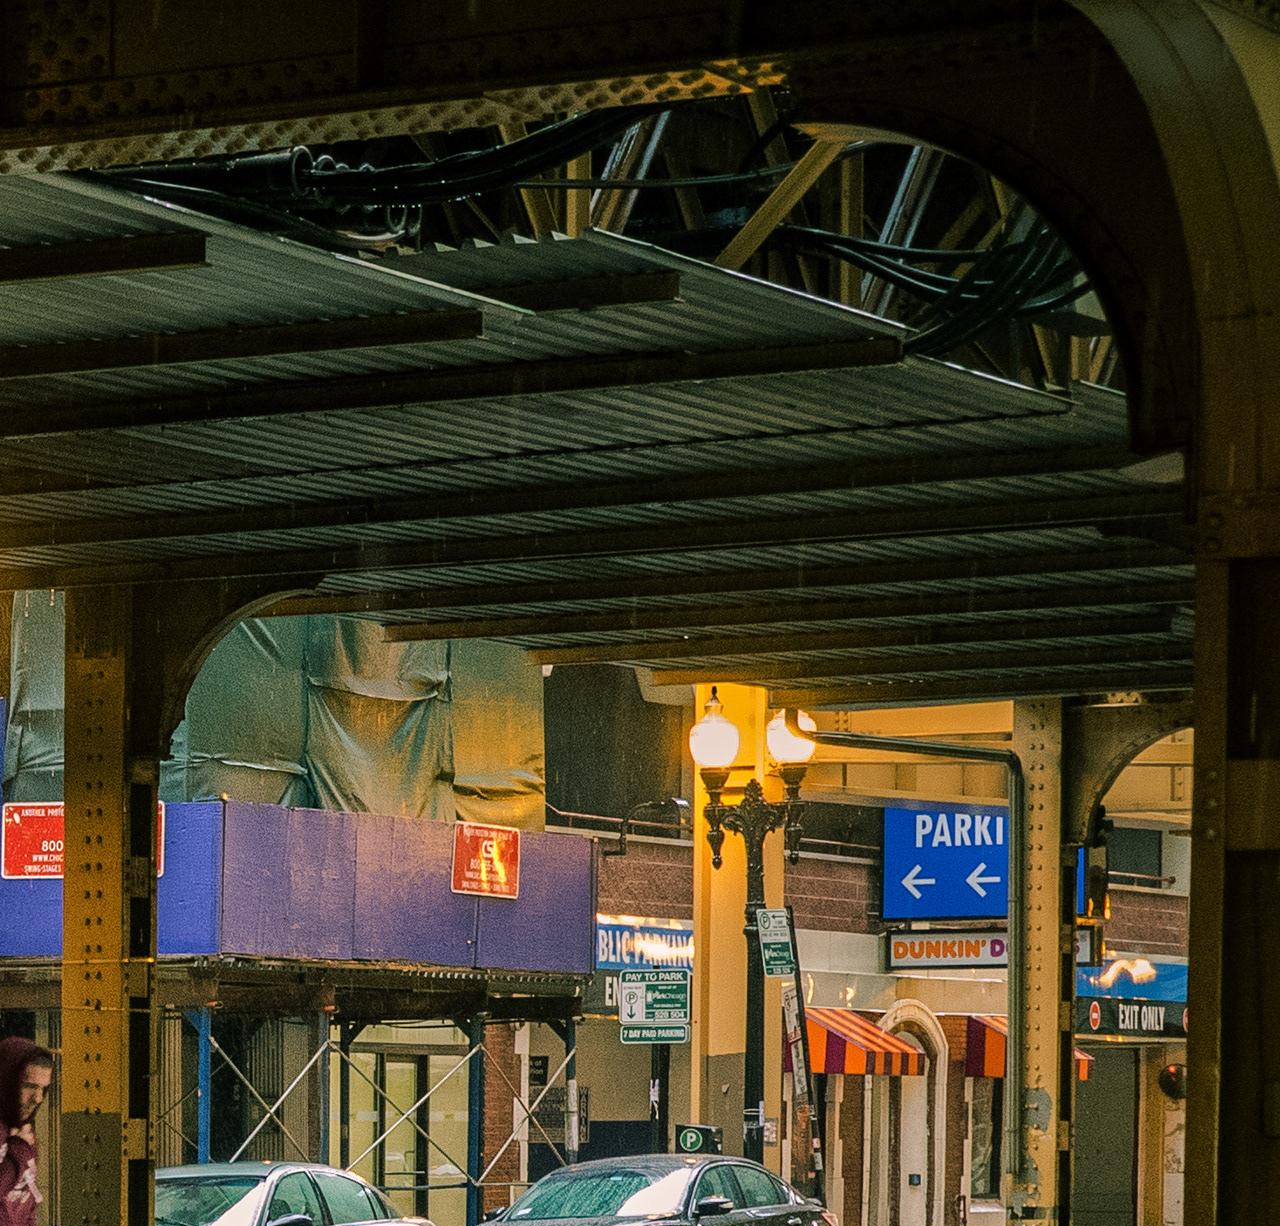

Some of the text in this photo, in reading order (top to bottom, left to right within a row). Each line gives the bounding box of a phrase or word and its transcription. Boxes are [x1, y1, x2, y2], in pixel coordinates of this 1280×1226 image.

[893, 939, 987, 960] DUNKIN'
[625, 972, 684, 982] PAY TO PARK
[1119, 1004, 1165, 1031] EXIT ONLY
[629, 1030, 641, 1038] DAY
[642, 1029, 657, 1038] PAID
[658, 1029, 684, 1037] PARKING
